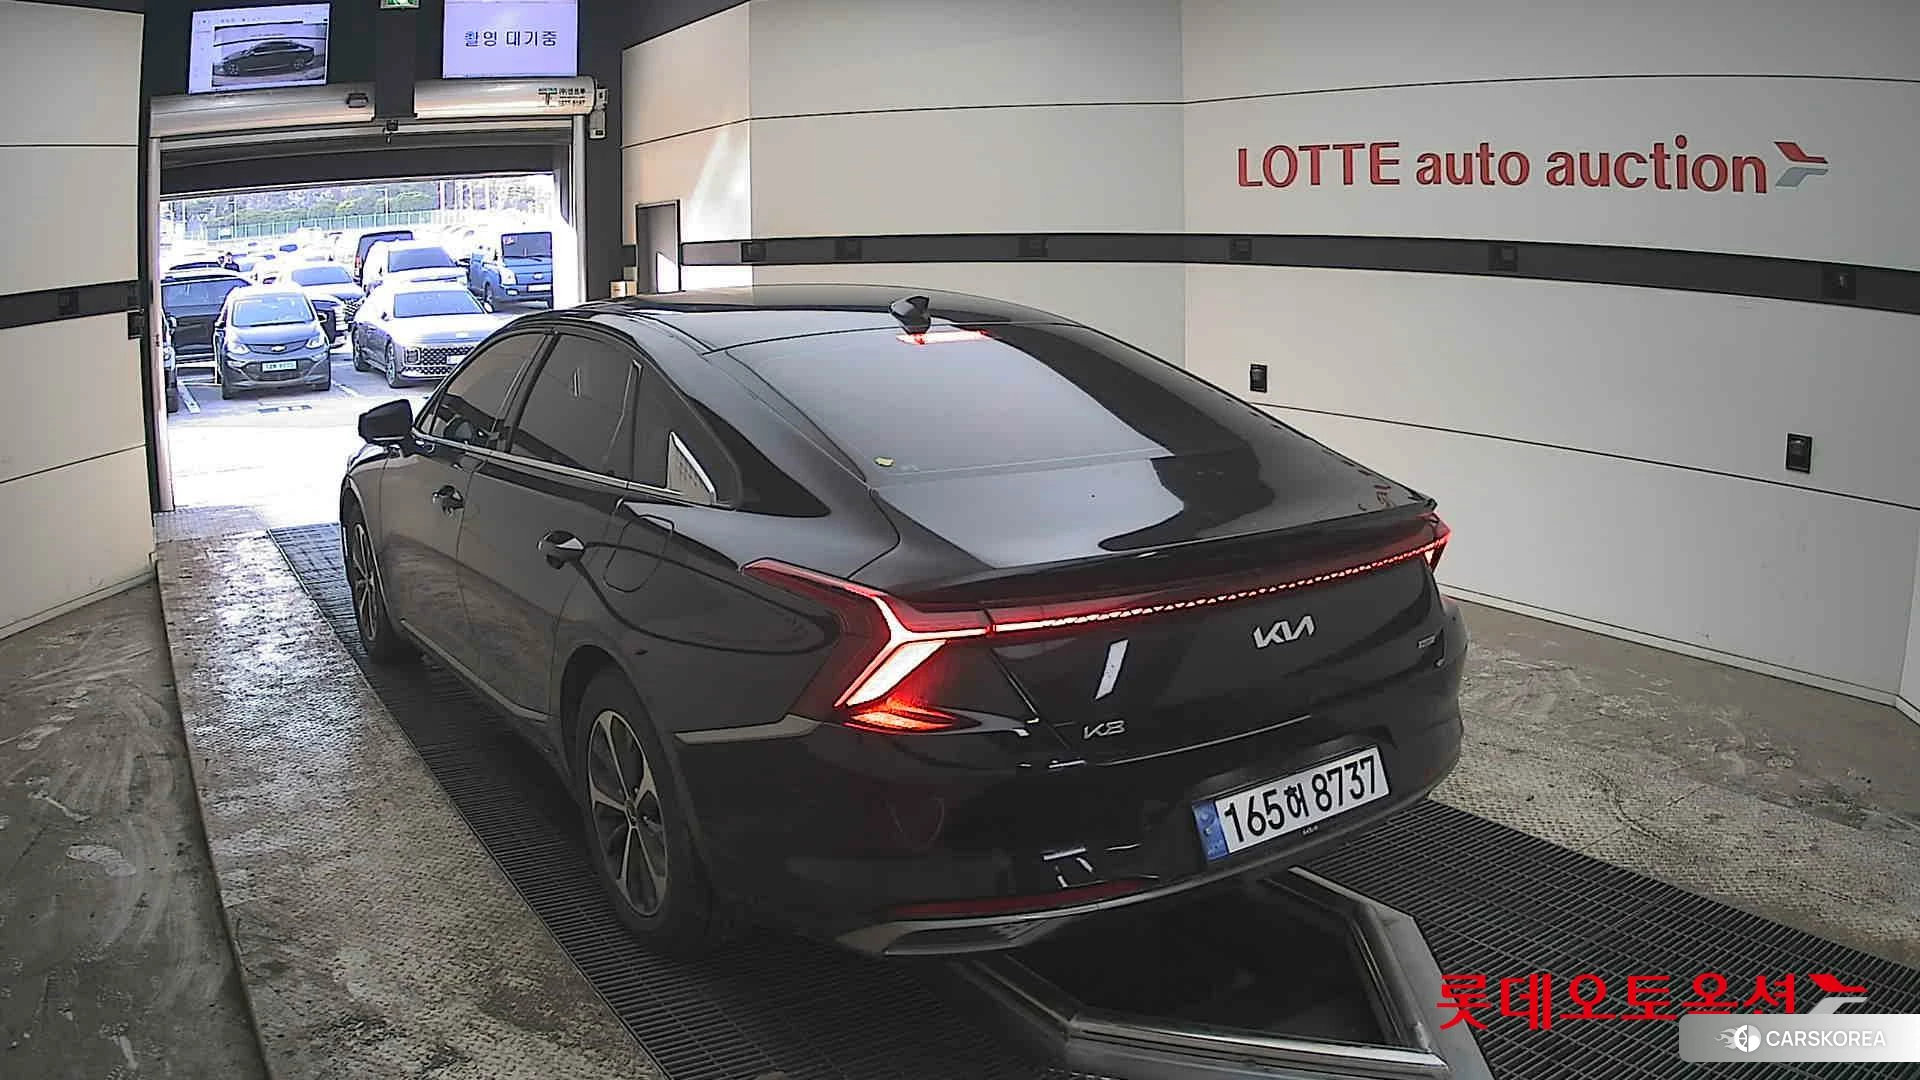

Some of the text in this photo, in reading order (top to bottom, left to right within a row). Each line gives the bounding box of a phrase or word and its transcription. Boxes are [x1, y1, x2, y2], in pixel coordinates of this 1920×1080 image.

[506, 30, 557, 47] 대기중
[1237, 134, 1767, 193] LOTTE auto auction
[1252, 614, 1316, 649] KIA
[1083, 720, 1127, 741] K8
[1224, 754, 1377, 843] 165허 8737
